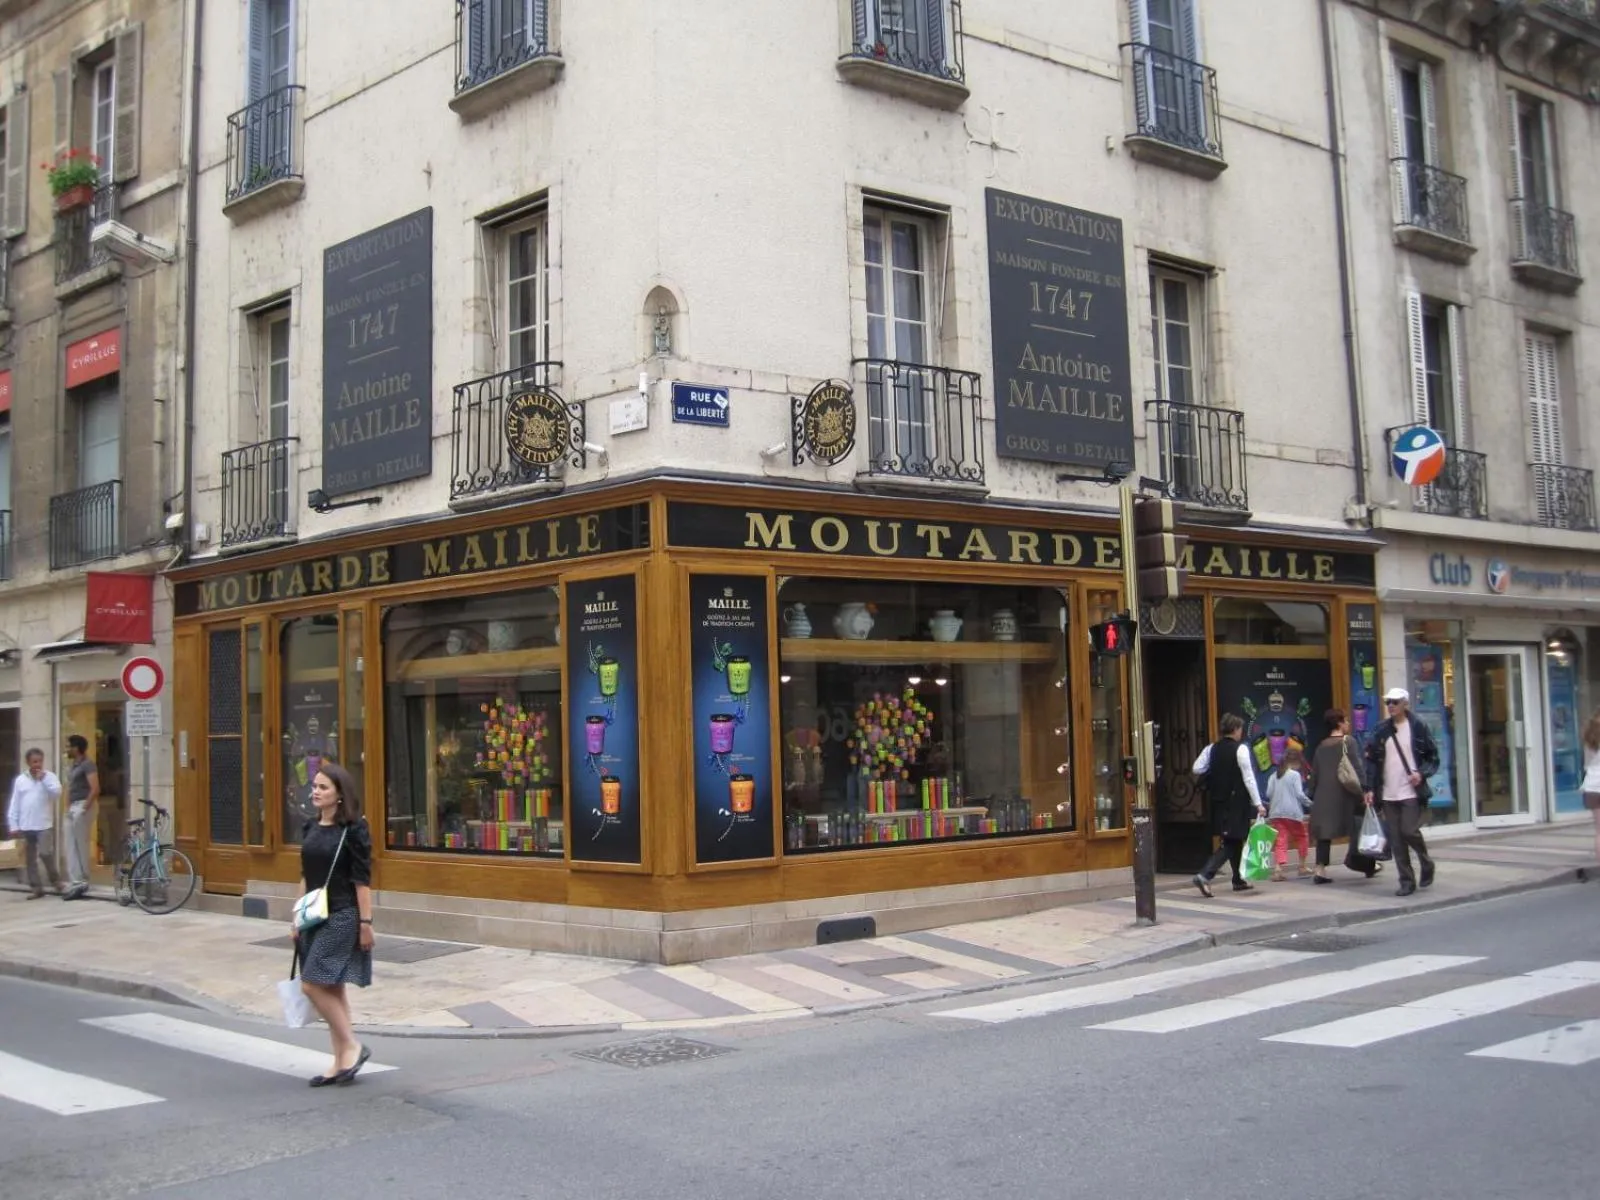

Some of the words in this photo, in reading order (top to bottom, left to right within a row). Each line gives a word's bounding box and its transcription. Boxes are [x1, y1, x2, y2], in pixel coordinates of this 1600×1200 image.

[994, 196, 1118, 243] EXPORTATION
[327, 216, 425, 273] EXPORTATION
[996, 251, 1047, 272] MAISON
[1105, 274, 1122, 288] EN
[1029, 281, 1093, 321] 1747
[348, 303, 400, 348] 1747
[72, 344, 116, 369] CYRILLUS
[1018, 342, 1112, 383] Antoine
[337, 372, 411, 411] Antoine
[516, 395, 560, 412] MAILLE
[690, 391, 712, 403] RUE
[1007, 378, 1124, 422] MAILLE
[328, 398, 421, 450] MAILLE
[677, 406, 686, 415] DE
[686, 407, 695, 416] LA
[376, 453, 424, 478] DETAIL
[1006, 434, 1050, 453] GROS
[1074, 442, 1129, 462] DETAIL
[744, 511, 1121, 568] MOUTARDE
[197, 549, 391, 611] MOUTARDE
[422, 514, 602, 576] MAILLE
[1429, 552, 1472, 586] Club
[584, 600, 619, 613] MAILLE
[708, 598, 750, 609] MAILLE
